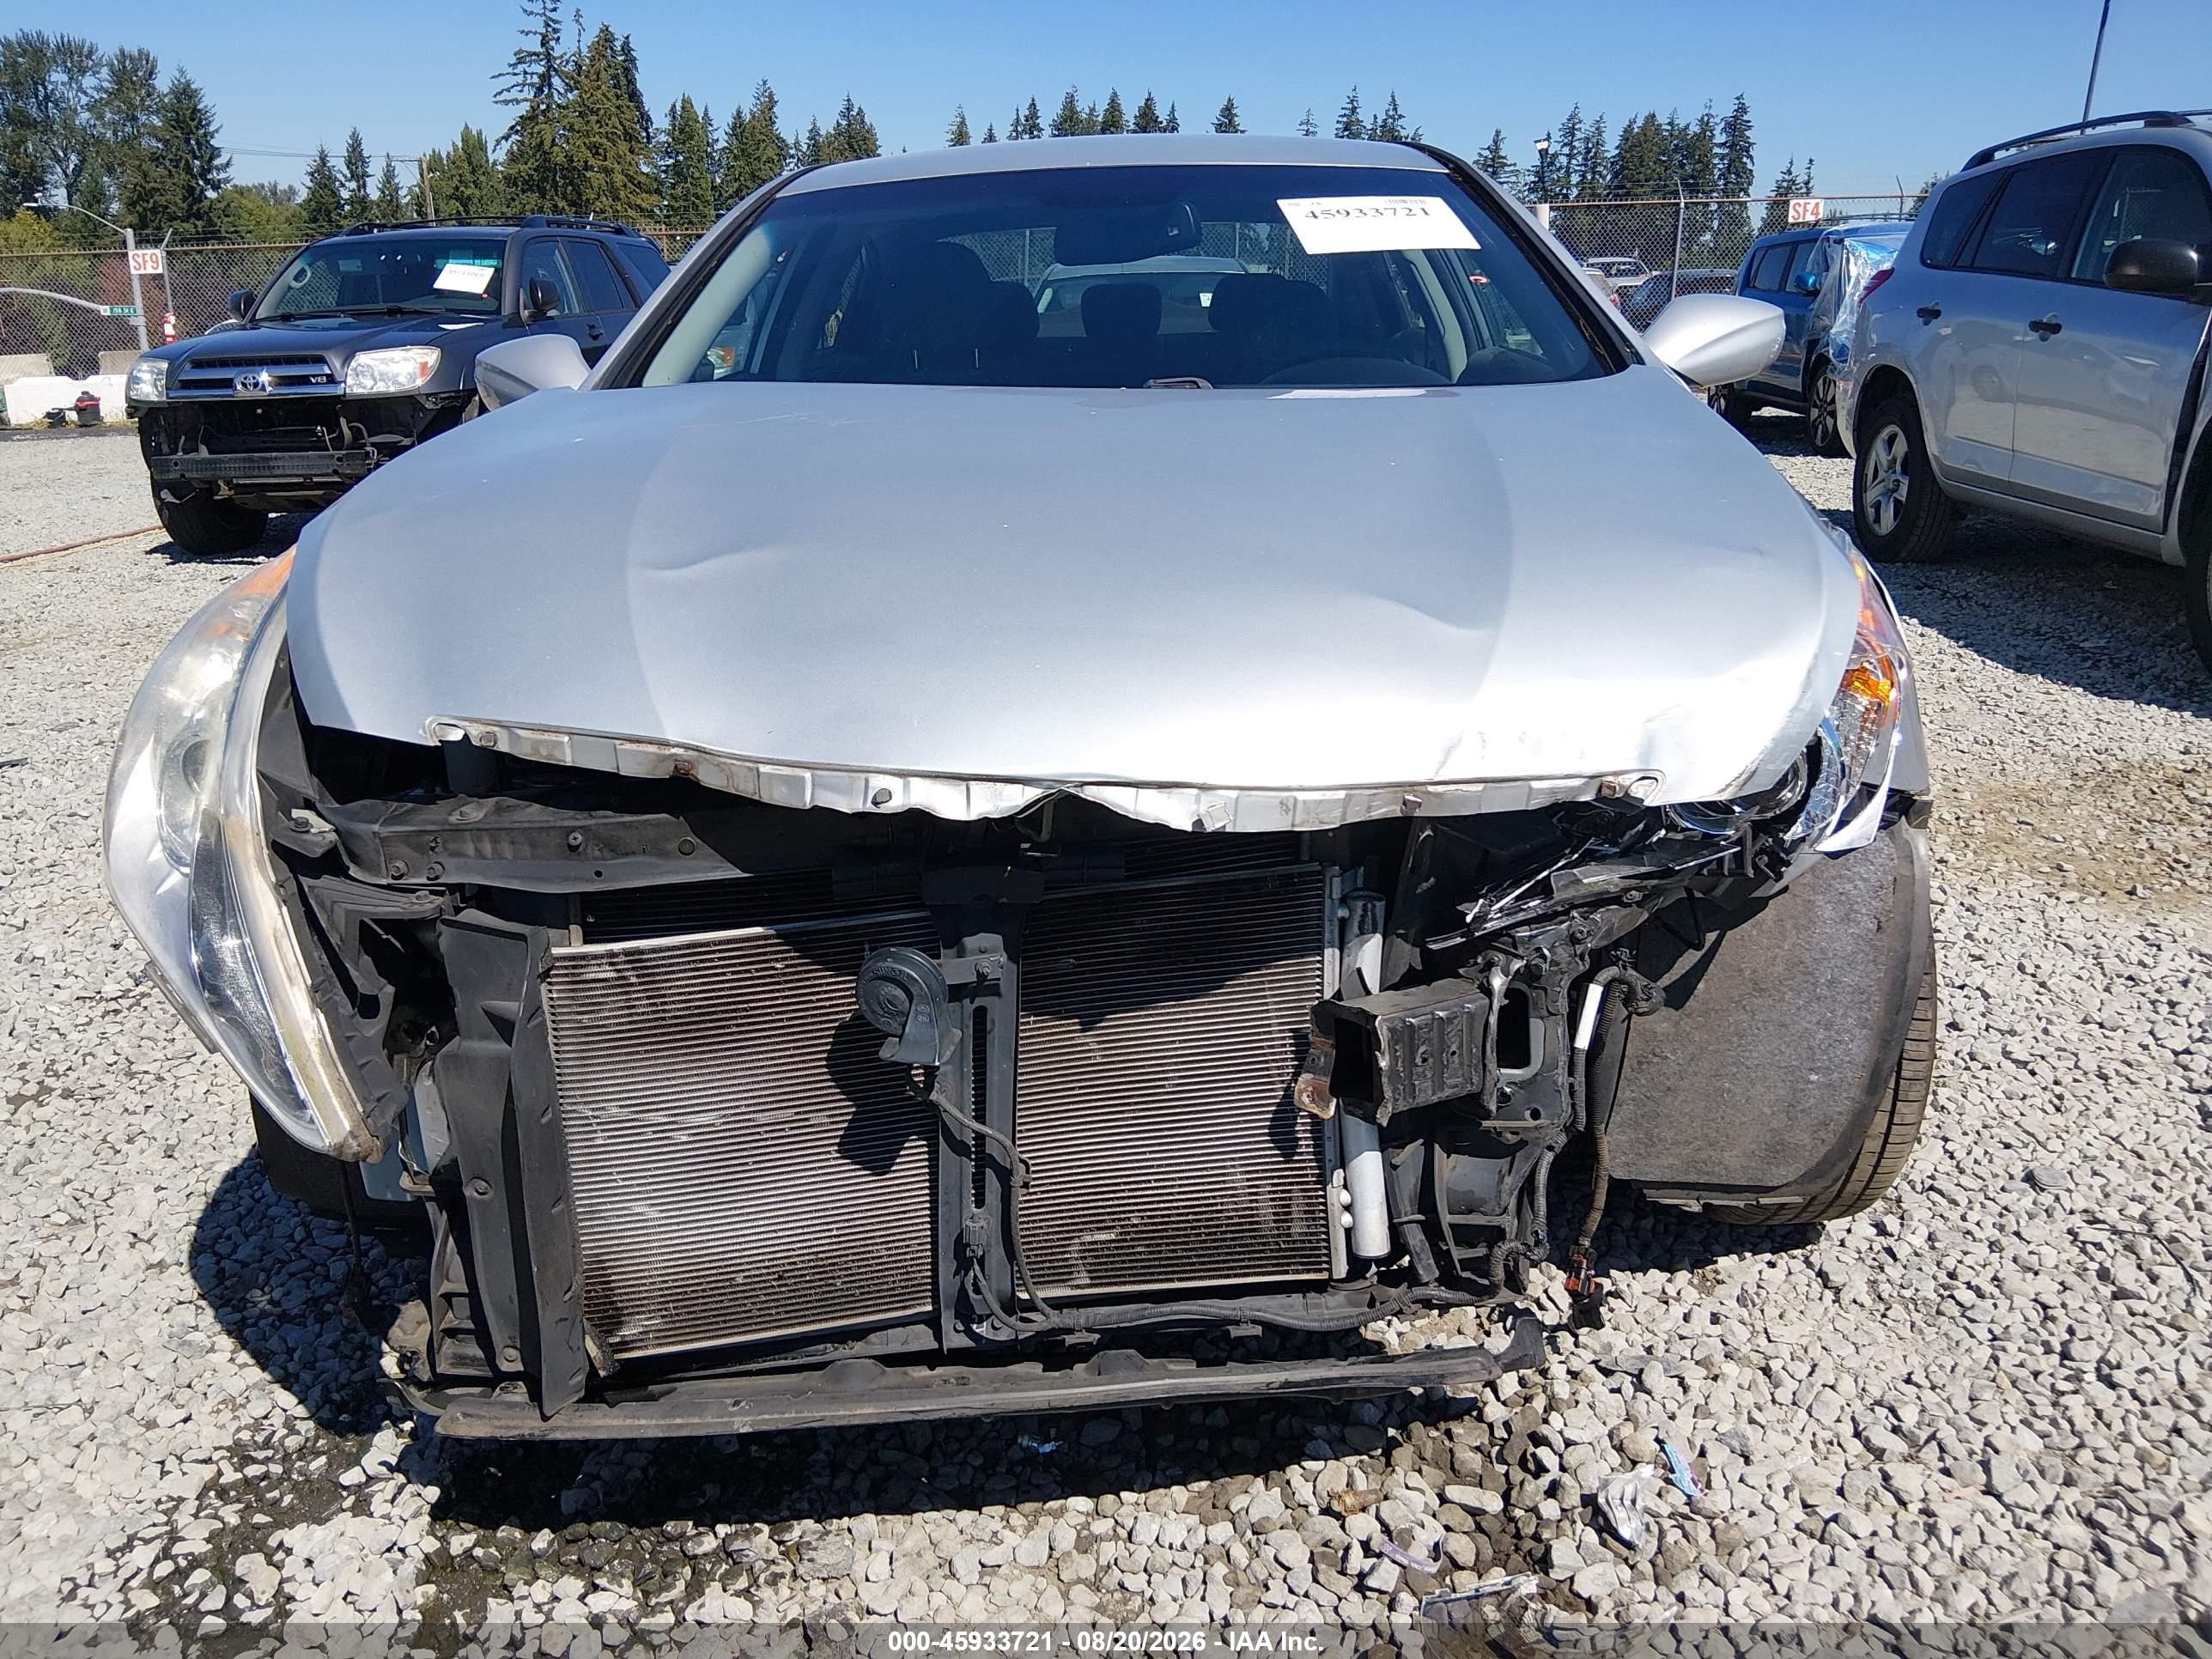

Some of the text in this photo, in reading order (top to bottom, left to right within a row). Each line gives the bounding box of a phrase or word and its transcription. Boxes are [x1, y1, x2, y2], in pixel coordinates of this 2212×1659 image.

[1304, 207, 1431, 219] 45933721
[1791, 202, 1820, 221] SF4
[131, 252, 160, 270] SF9
